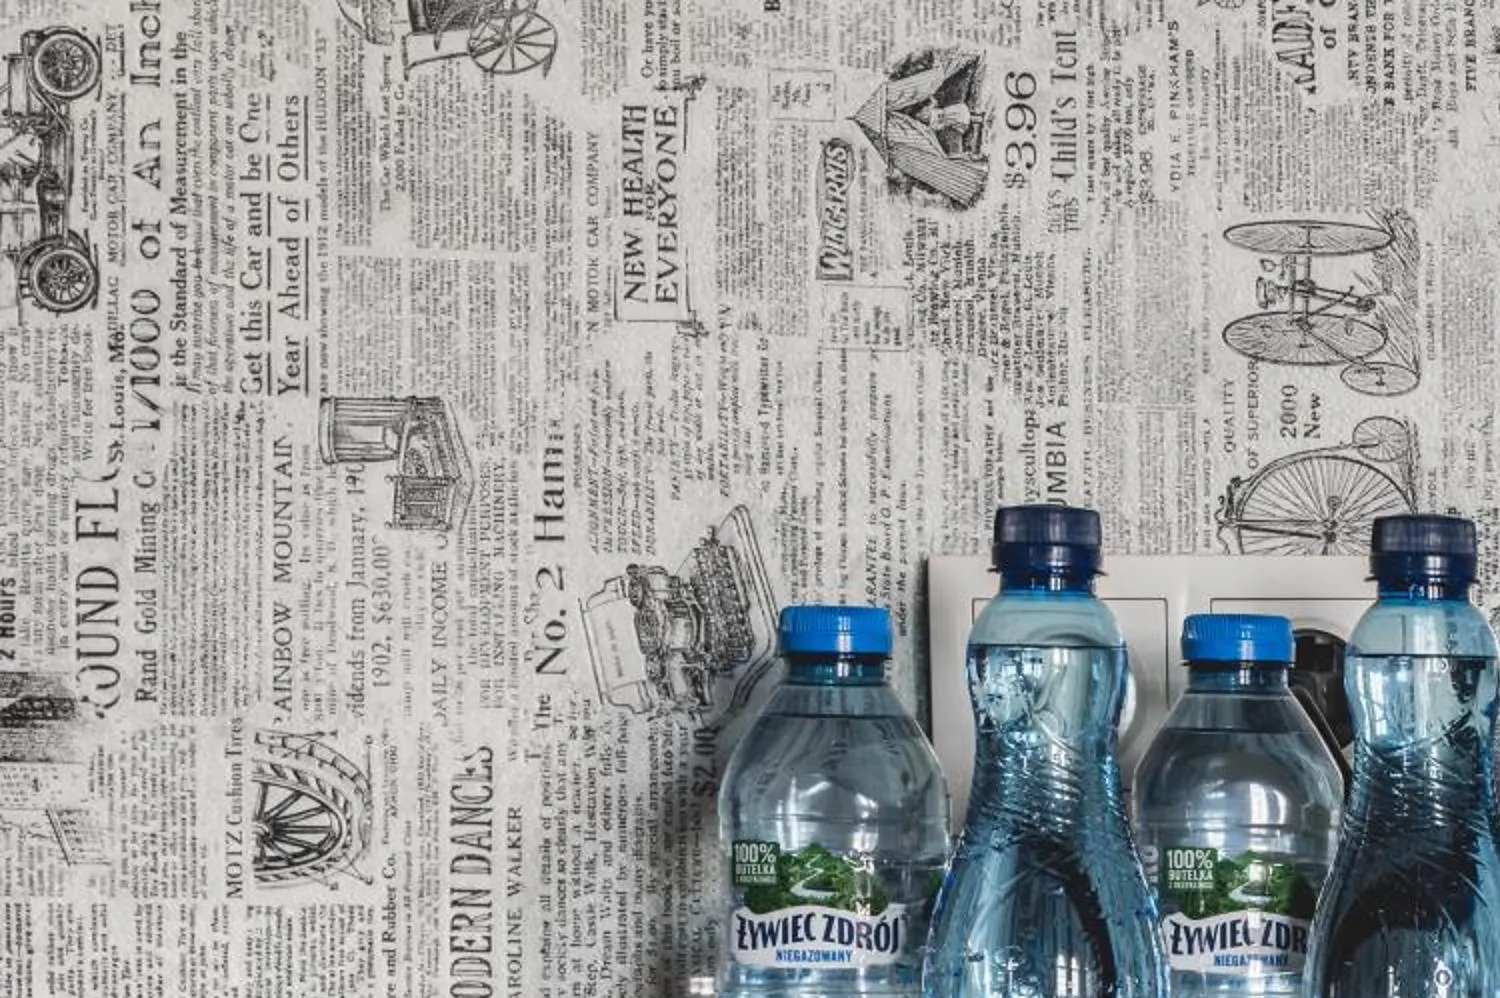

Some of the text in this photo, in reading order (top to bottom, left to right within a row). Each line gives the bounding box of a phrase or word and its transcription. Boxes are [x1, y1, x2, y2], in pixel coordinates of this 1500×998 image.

[131, 121, 161, 189] An
[238, 155, 262, 182] be
[171, 31, 188, 366] the Standard of Measurement in the
[238, 193, 262, 237] and
[621, 104, 648, 303] NEW HEALTH
[654, 106, 680, 305] EVERYONE
[130, 218, 161, 260] of
[277, 95, 300, 395] Year Ahead of Others
[239, 248, 262, 290] Car
[238, 300, 262, 342] this
[239, 352, 262, 394] Get
[1303, 393, 1322, 439] New
[134, 501, 160, 702] Rand Gold Mining
[432, 562, 447, 648] INCOME
[535, 564, 566, 676] No. 2
[226, 832, 243, 897] MOTZ
[507, 807, 522, 897] WALKER
[735, 843, 776, 863] 100%
[1167, 849, 1213, 868] 100%
[382, 886, 397, 942] Rubber
[822, 913, 899, 954] ZDRÓJ
[382, 949, 397, 976] and
